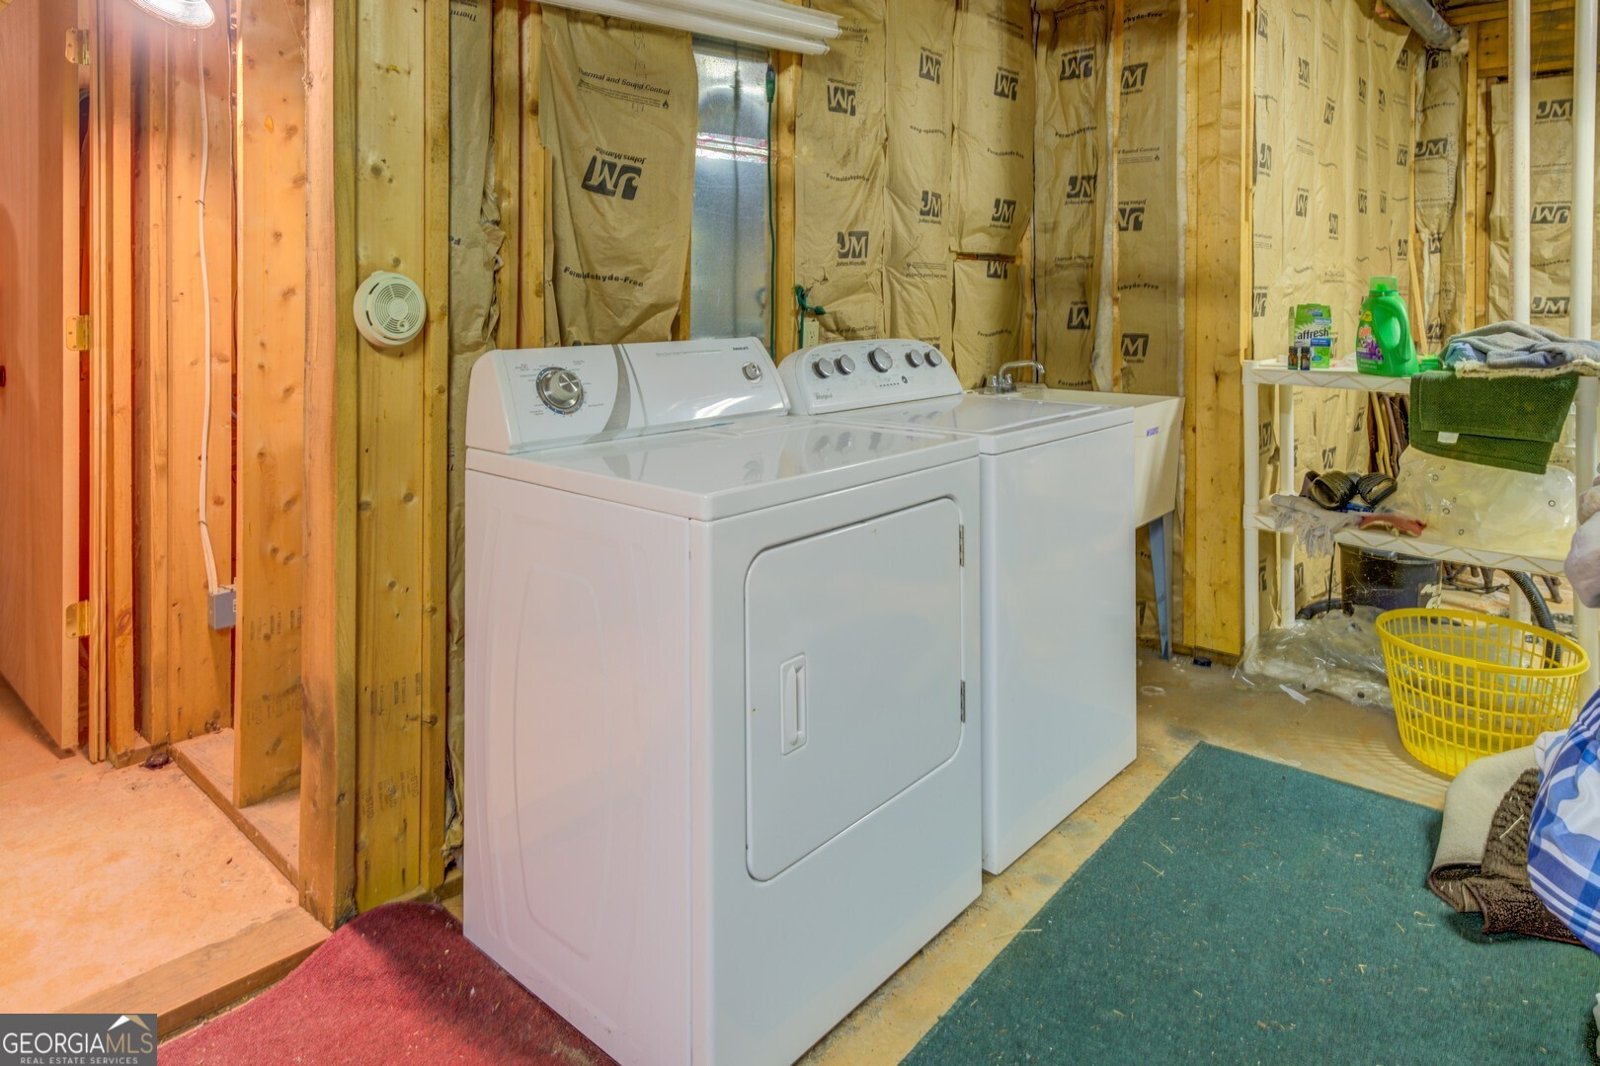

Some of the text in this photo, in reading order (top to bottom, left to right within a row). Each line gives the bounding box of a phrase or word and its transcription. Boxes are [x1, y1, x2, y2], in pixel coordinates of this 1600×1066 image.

[919, 52, 941, 84] JM
[1060, 54, 1094, 81] JM
[1120, 62, 1148, 90] M
[606, 76, 620, 84] and
[645, 83, 670, 95] Control
[994, 71, 1018, 101] JM
[827, 84, 856, 117] JM
[1536, 98, 1573, 120] JM
[623, 154, 647, 164] Johns
[1415, 138, 1448, 157] JM
[581, 155, 642, 201] JM
[919, 190, 942, 219] JM
[992, 198, 1016, 224] JM
[1531, 205, 1571, 225] JM
[837, 230, 869, 259] JM
[1067, 306, 1091, 330] M
[1530, 297, 1570, 315] JM
[1120, 333, 1149, 358] M
[1297, 328, 1329, 340] affresh
